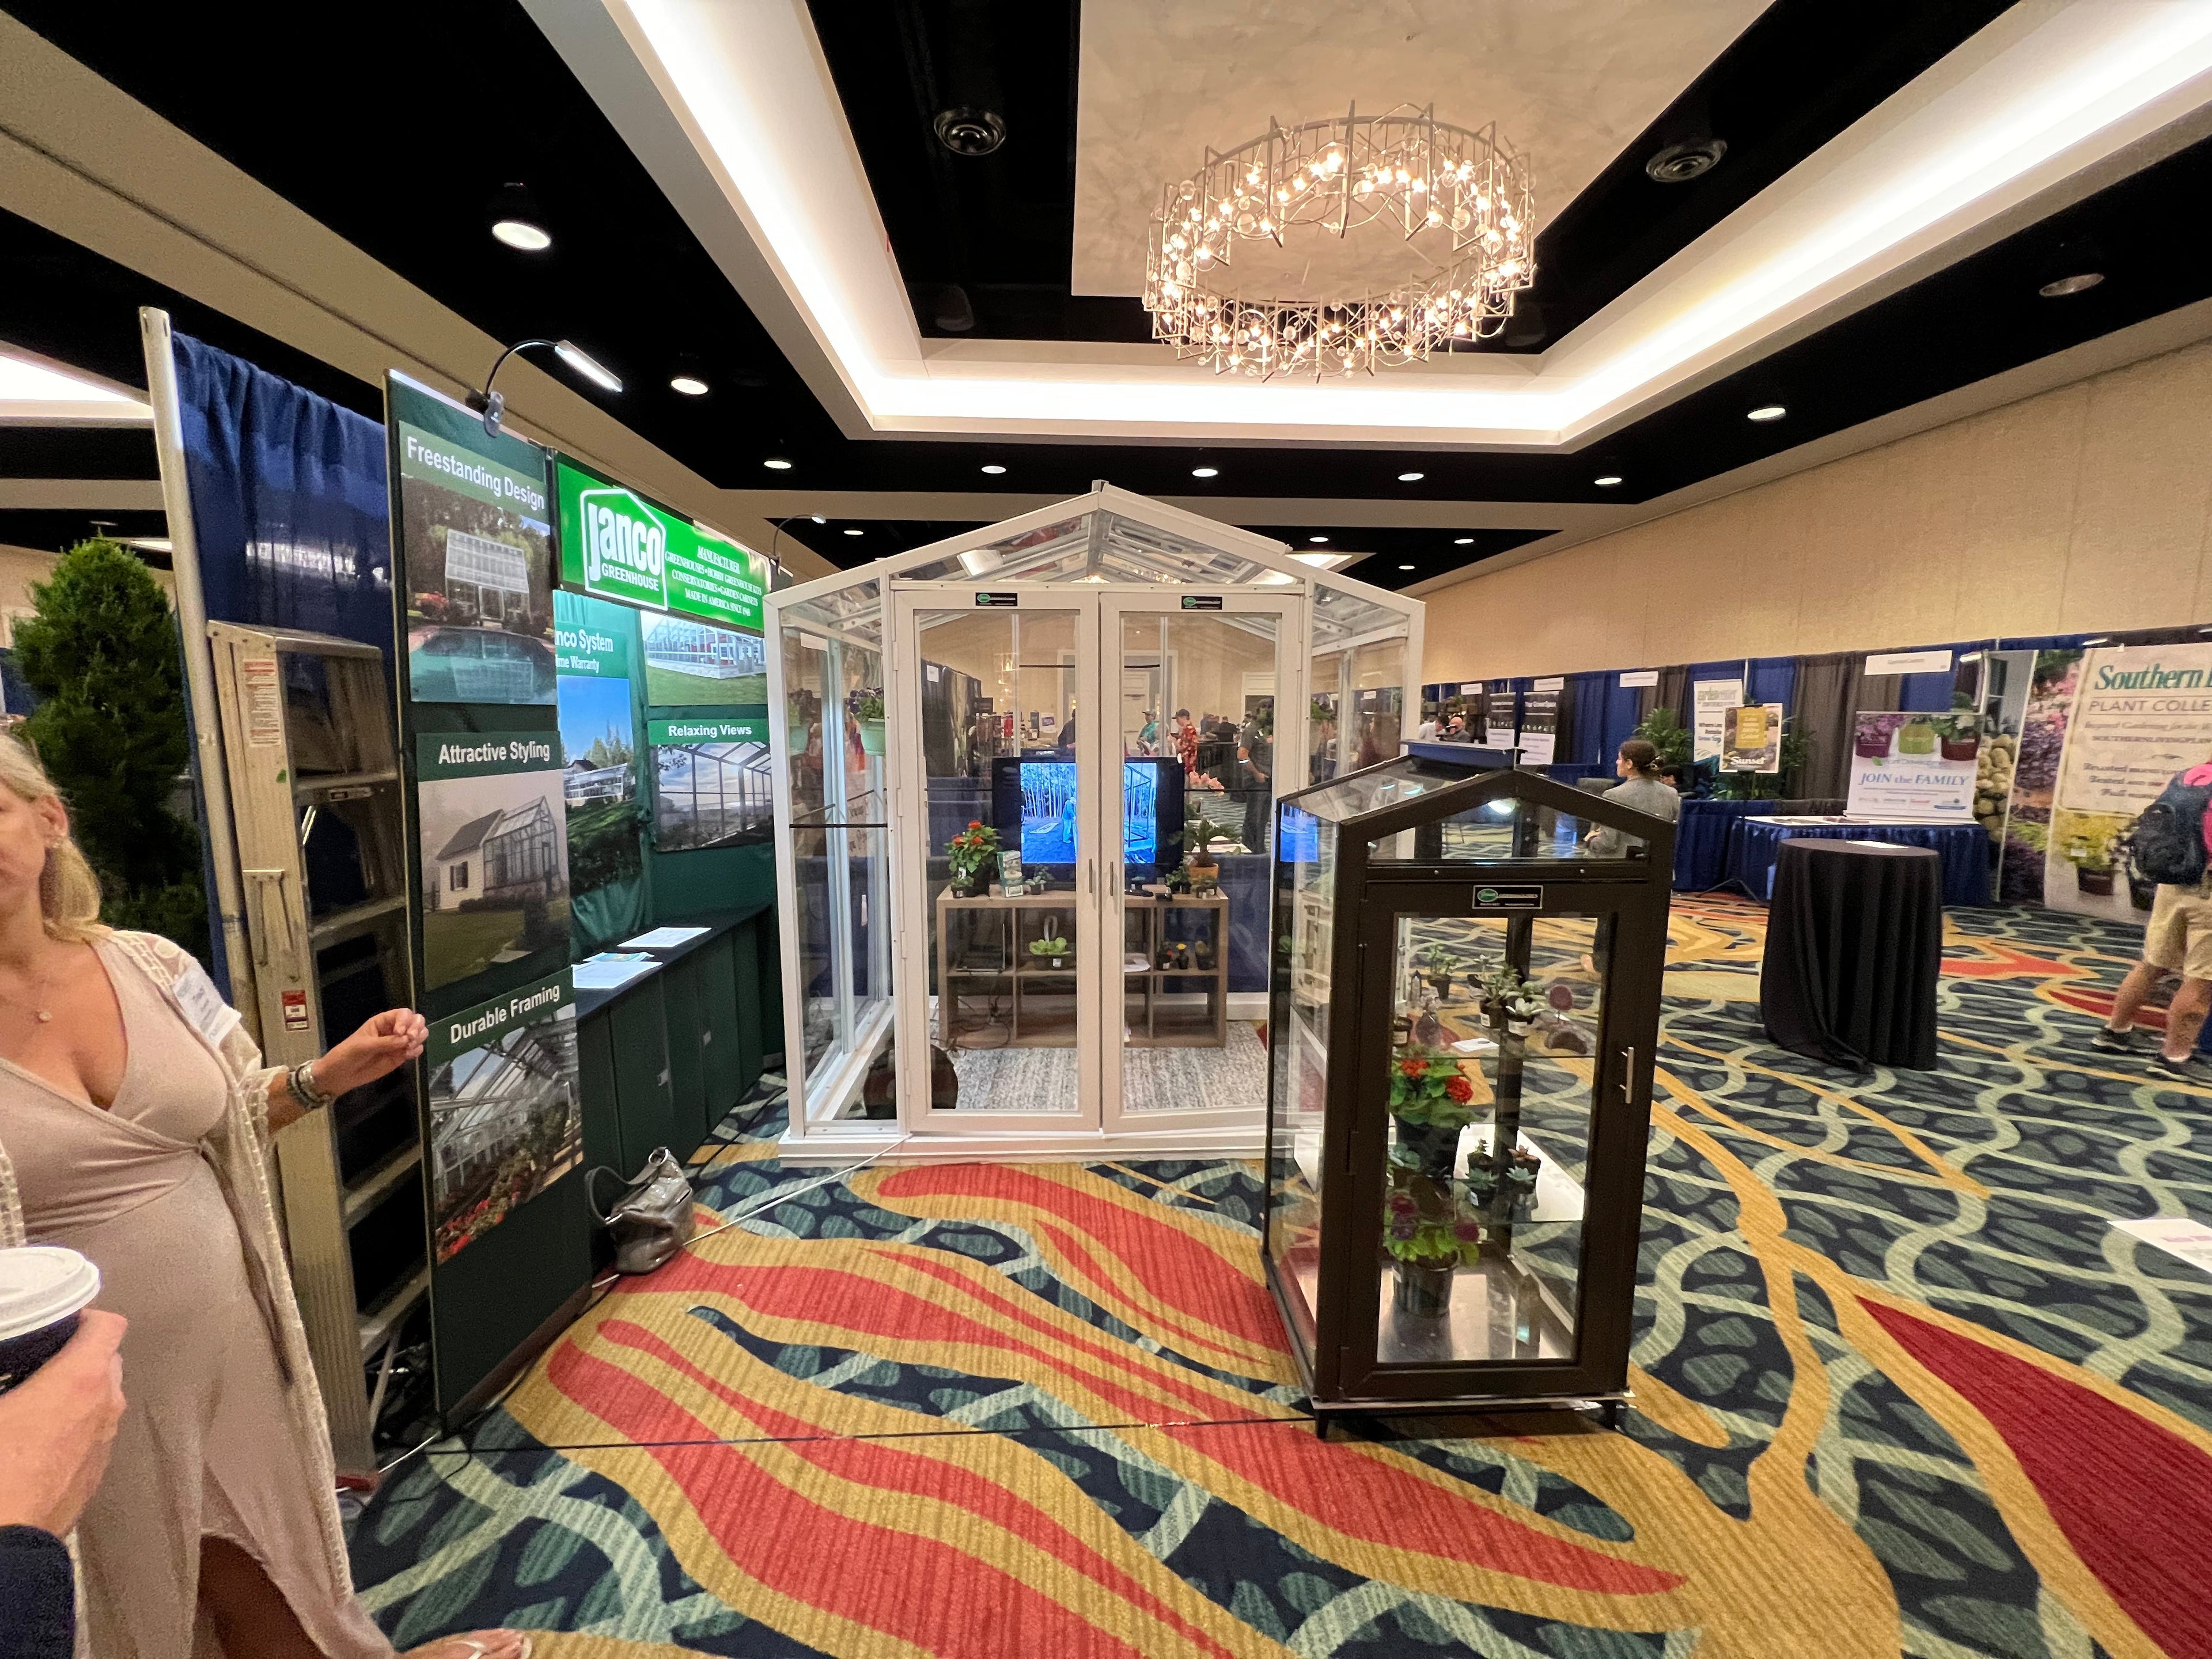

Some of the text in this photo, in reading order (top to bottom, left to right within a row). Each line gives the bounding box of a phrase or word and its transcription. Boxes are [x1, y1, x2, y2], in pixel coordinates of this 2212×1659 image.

[407, 436, 545, 511] Freestanding Design
[588, 502, 661, 582] Janco
[601, 563, 659, 592] GREENHOUSE
[665, 551, 704, 574] GREENHOUSES
[725, 574, 752, 592] GREENHOUSE
[672, 569, 717, 593] CONSERVATORIES
[719, 586, 739, 600] GARDEN
[685, 588, 702, 602] MADE
[702, 593, 708, 603] IN
[708, 596, 730, 611] AMERICA
[579, 629, 613, 654] System
[570, 656, 600, 673] Warranty
[2094, 663, 2204, 690] Southern
[2089, 700, 2149, 711] PLANT
[668, 724, 752, 738] Relaxing Views
[438, 741, 550, 764] Attractive Styling
[1730, 756, 1766, 765] Sunset
[1858, 773, 1969, 786] JOIN the FAMILY
[450, 985, 560, 1044] Durable Framing
